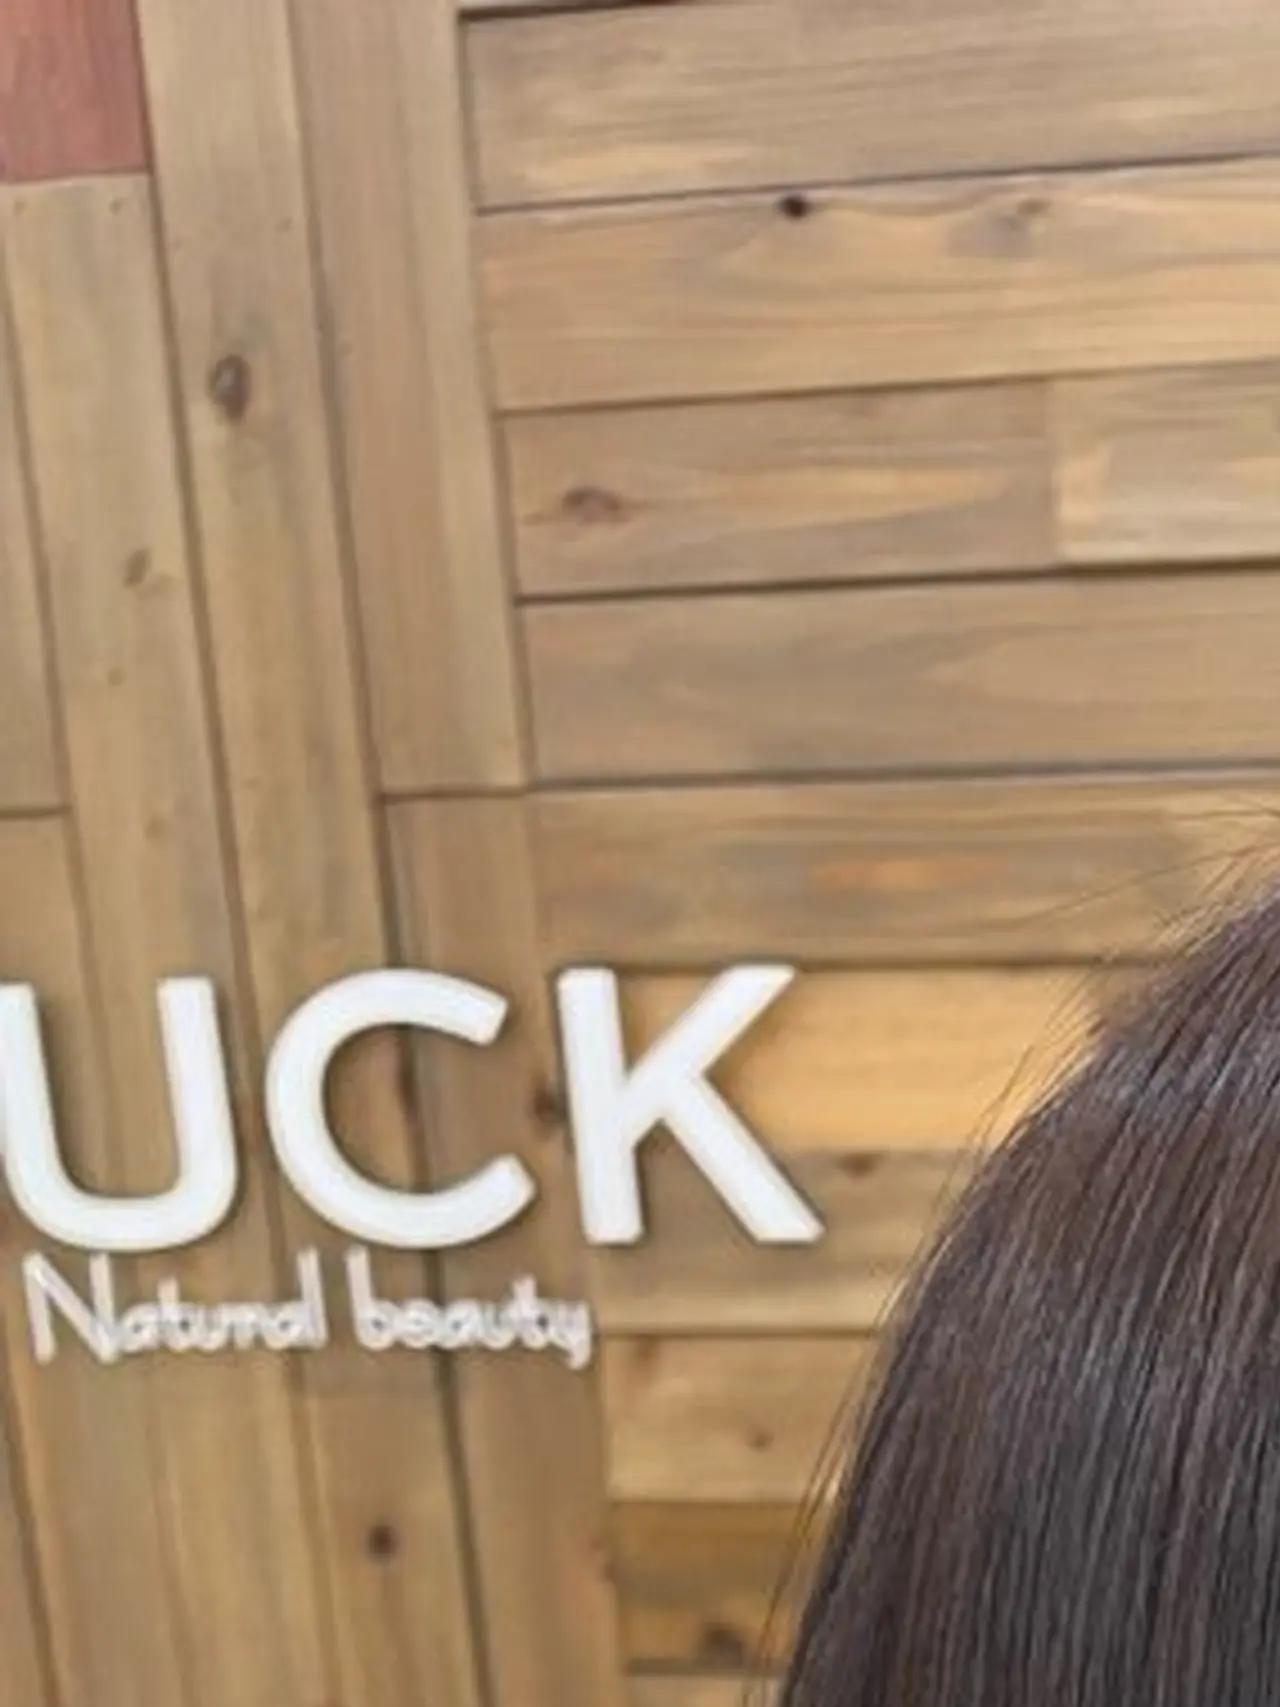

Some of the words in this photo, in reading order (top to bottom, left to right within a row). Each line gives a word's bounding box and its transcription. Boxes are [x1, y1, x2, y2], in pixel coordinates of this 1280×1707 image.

[0, 963, 825, 1251] UCK
[22, 1244, 329, 1365] Natural
[345, 1244, 592, 1370] beauty
